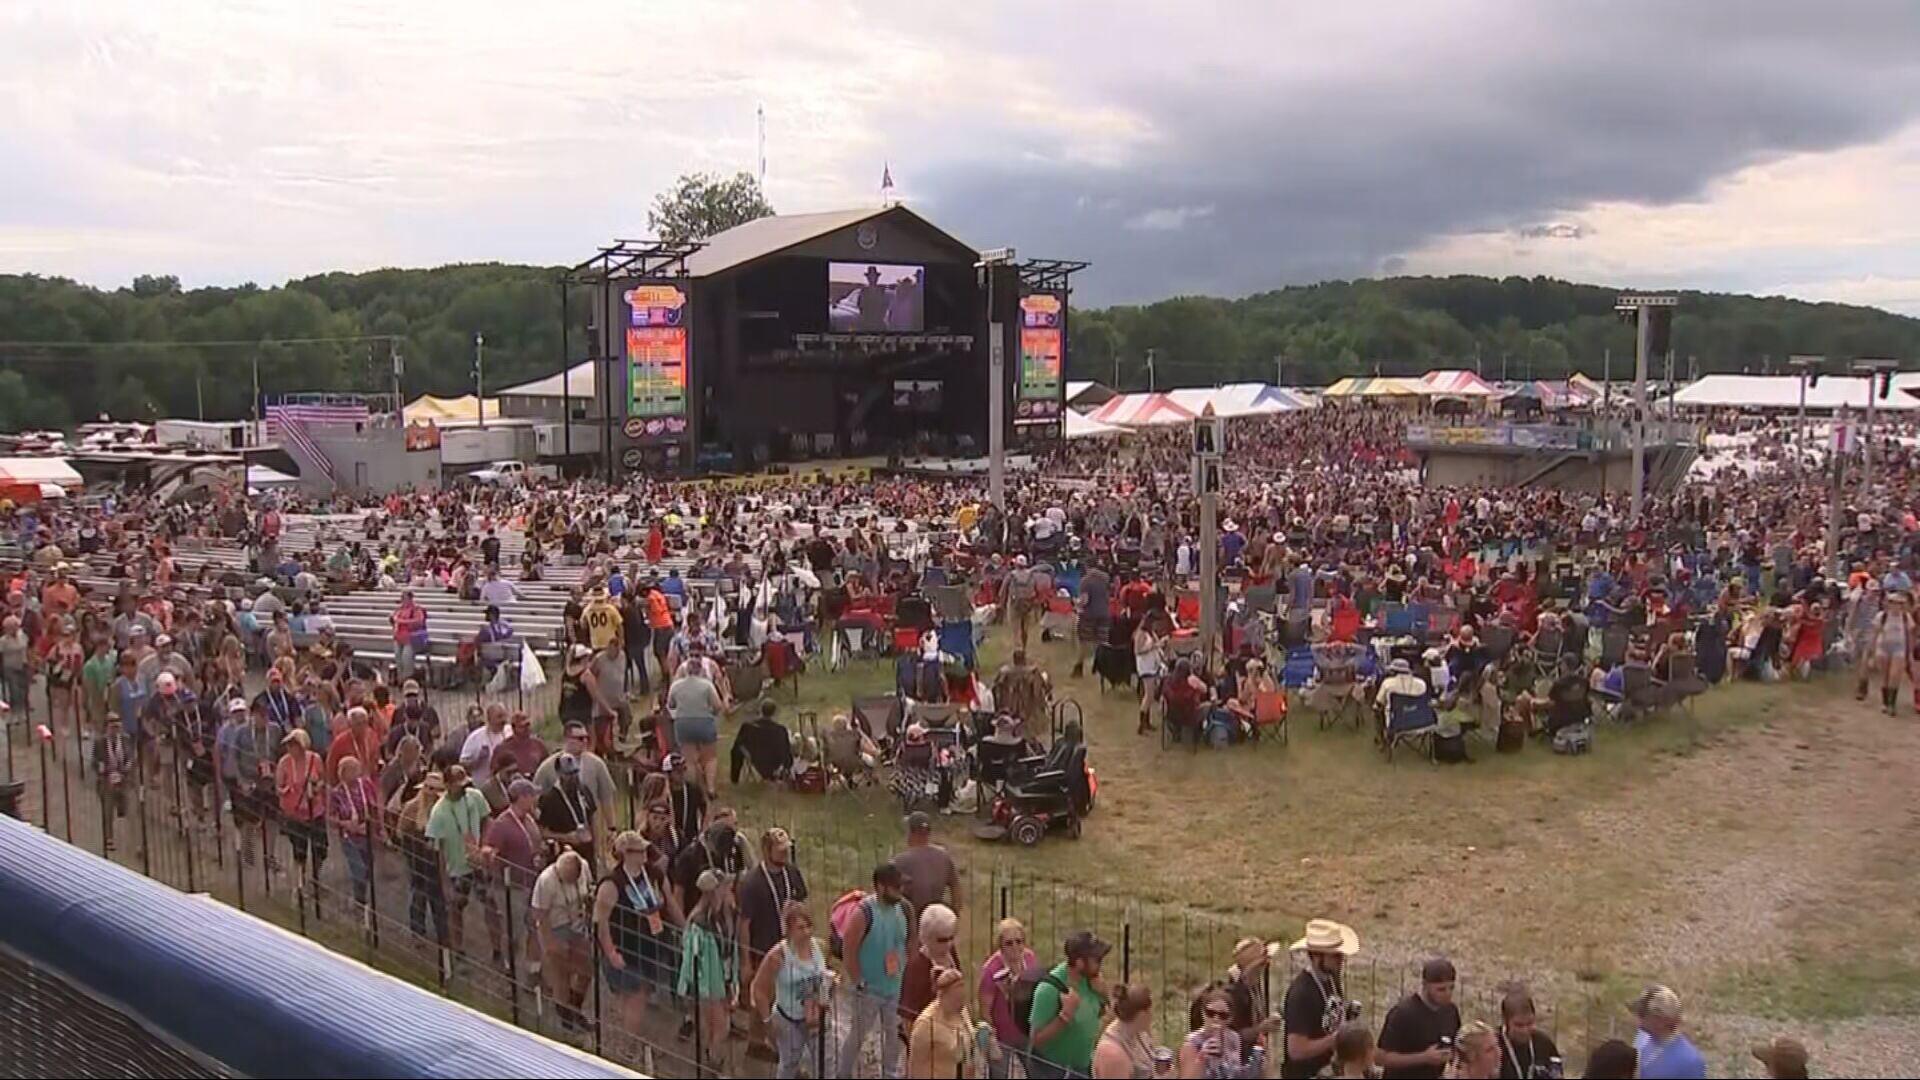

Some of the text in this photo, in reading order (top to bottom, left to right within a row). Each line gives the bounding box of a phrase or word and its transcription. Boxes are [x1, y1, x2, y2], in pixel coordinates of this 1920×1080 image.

[1196, 425, 1214, 452] A
[1835, 425, 1847, 448] 1
[1206, 466, 1219, 492] A
[592, 612, 608, 628] 00
